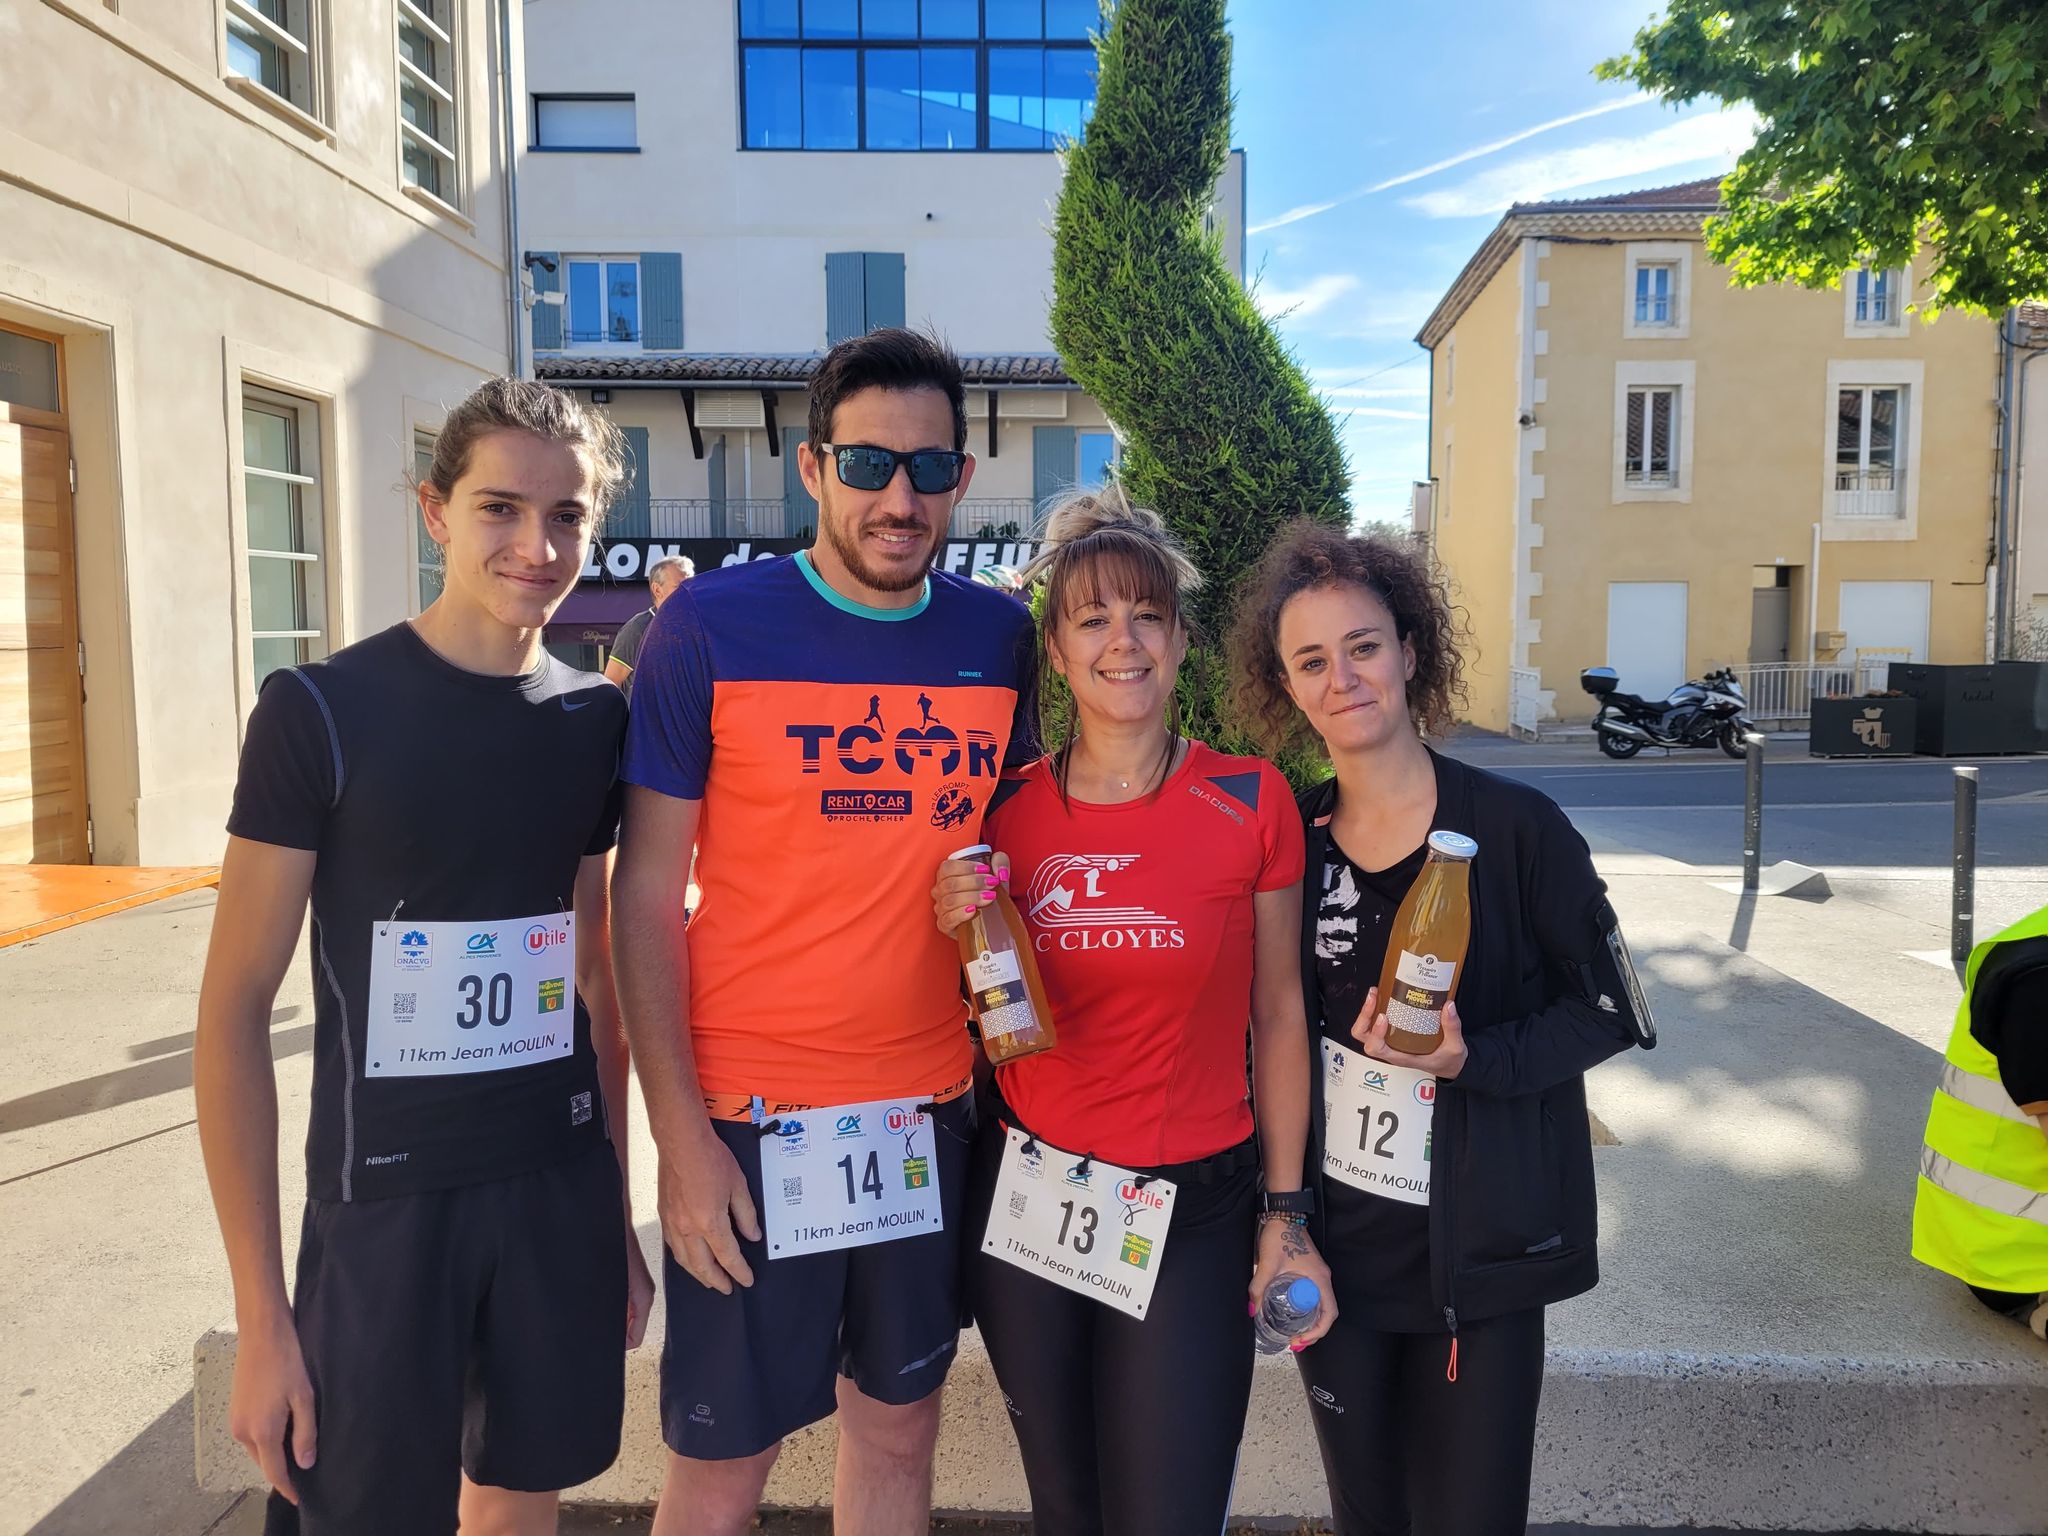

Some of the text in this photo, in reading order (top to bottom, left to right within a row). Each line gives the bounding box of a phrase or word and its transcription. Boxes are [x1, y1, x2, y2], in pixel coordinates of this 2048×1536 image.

[721, 543, 776, 568] d
[1188, 785, 1244, 826] DIADORA
[529, 929, 567, 949] Utile
[1059, 928, 1185, 950] CLOYES
[456, 972, 513, 1030] 30
[399, 1033, 556, 1063] 11km Jean MOULIN
[889, 1112, 925, 1129] Utile
[1357, 1105, 1400, 1160] 12
[781, 1143, 808, 1152] ONACVG
[837, 1150, 884, 1204] 14
[1324, 1149, 1430, 1194] km Jean MOULI
[1121, 1184, 1164, 1209] Utile
[794, 1209, 925, 1242] 11km Jean MOULIN
[1057, 1200, 1099, 1255] 13
[1006, 1238, 1133, 1299] 11km Jean MOULIN
